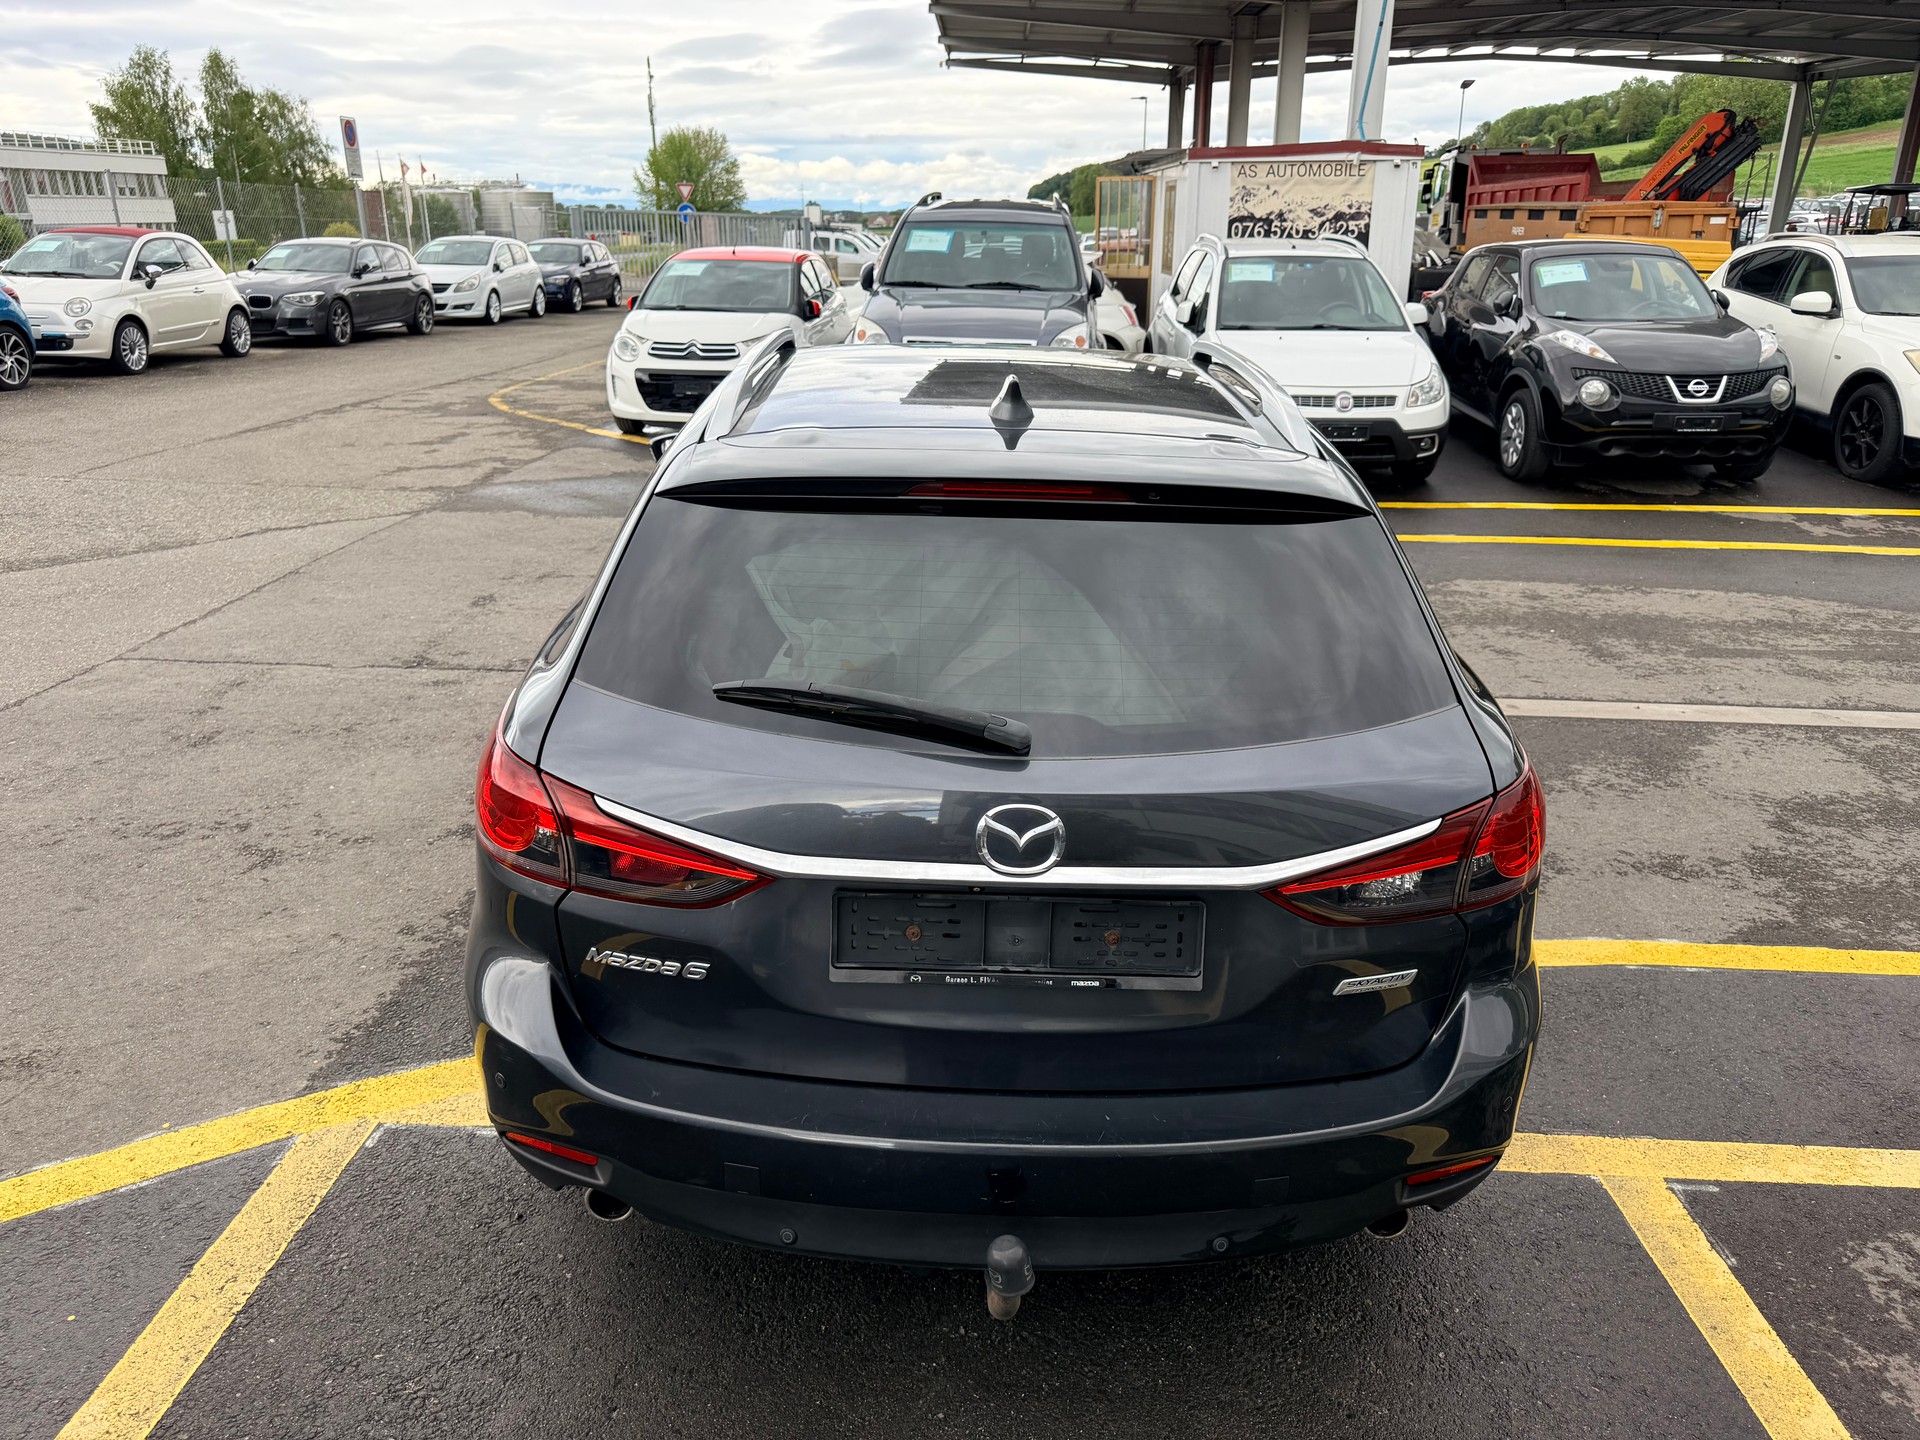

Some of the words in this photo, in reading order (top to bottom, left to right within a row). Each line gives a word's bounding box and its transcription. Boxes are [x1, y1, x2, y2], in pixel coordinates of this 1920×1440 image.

[1678, 125, 1706, 154] PALFINGER
[1237, 164, 1258, 178] AS
[1265, 163, 1367, 178] AUTOMOBILE
[1231, 222, 1265, 239] 076
[1271, 221, 1303, 239] 570
[1337, 221, 1359, 238] 25
[1346, 974, 1413, 987] SKYACTIV
